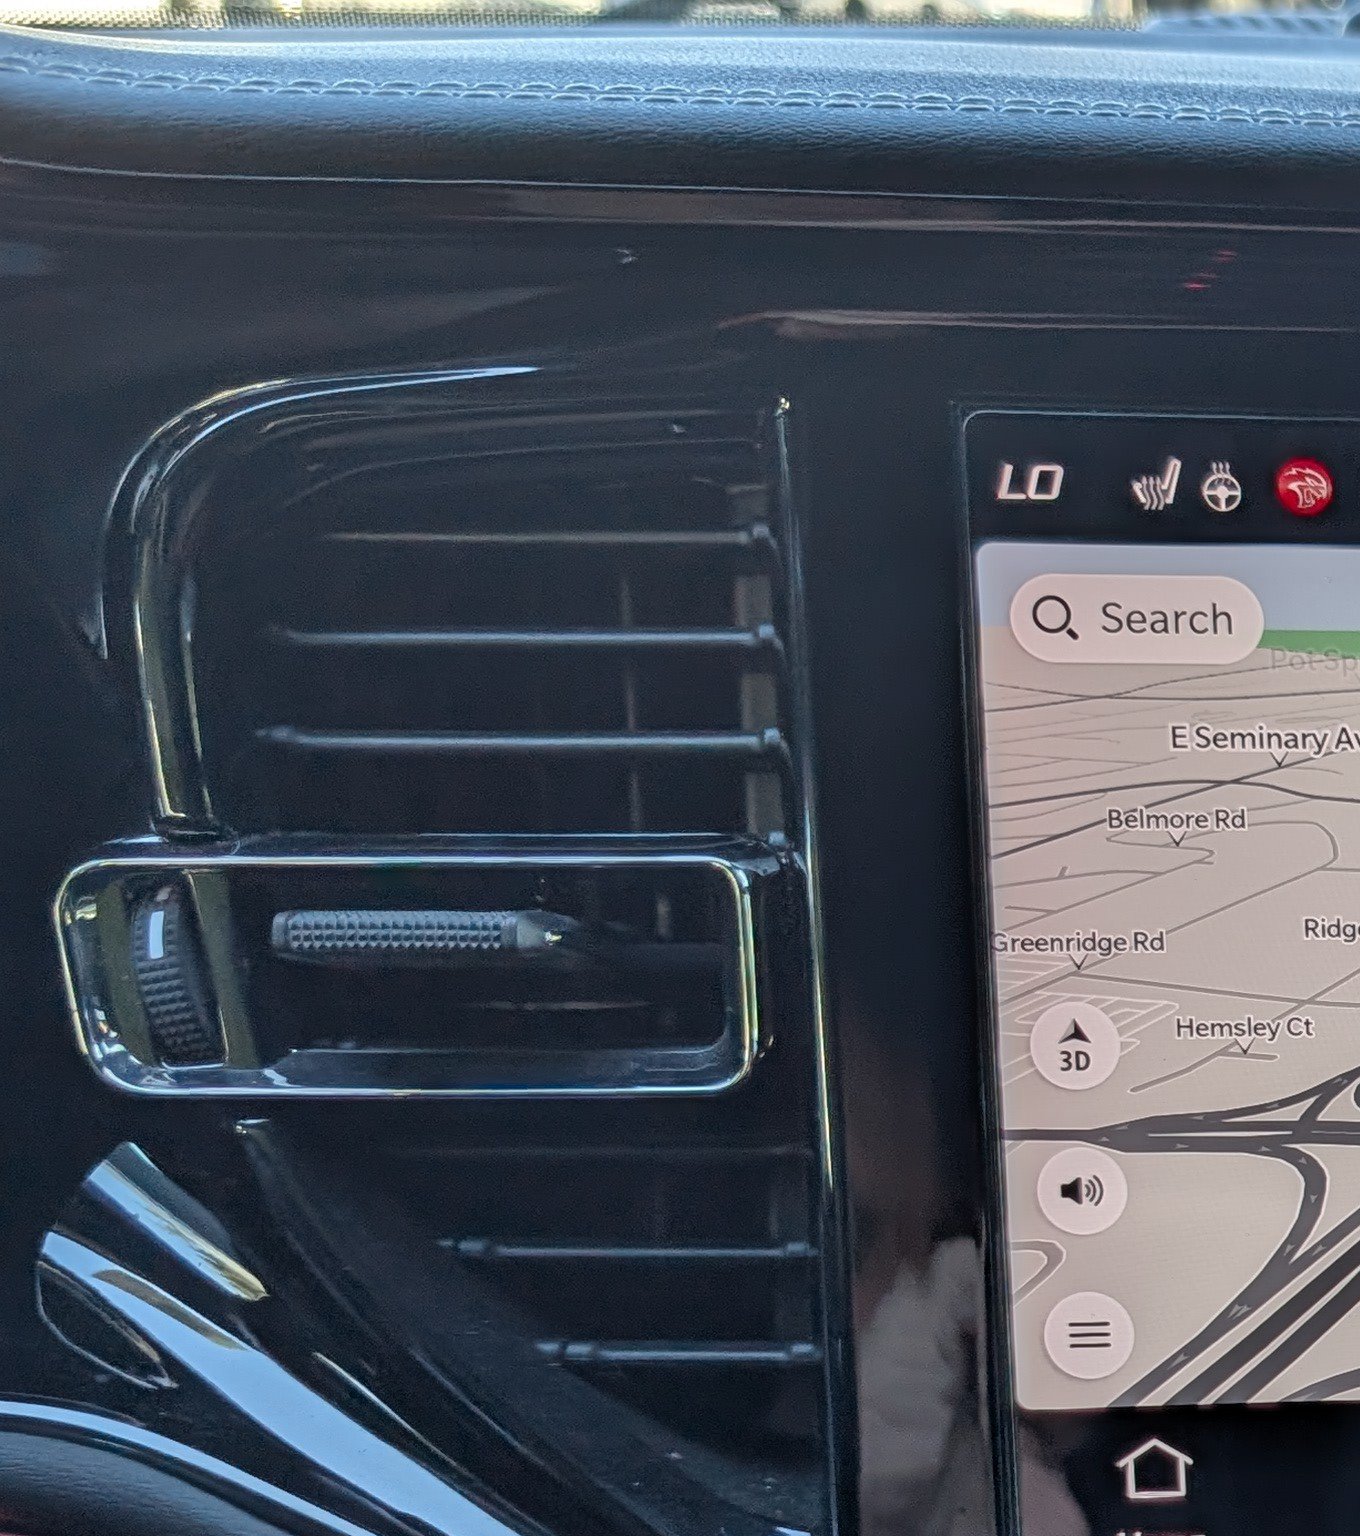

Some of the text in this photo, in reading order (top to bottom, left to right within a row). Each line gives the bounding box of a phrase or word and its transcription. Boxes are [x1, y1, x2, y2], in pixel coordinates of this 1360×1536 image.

[998, 463, 1064, 501] LO
[1100, 602, 1234, 636] Search
[1271, 647, 1316, 671] Pot
[1171, 727, 1191, 750] E
[1195, 726, 1331, 755] Seminary
[1108, 808, 1246, 830] Belmore Rd
[993, 931, 1165, 956] Greenridge Rd
[1176, 1017, 1314, 1042] Hemsley Ct
[1060, 1051, 1090, 1072] 3D
